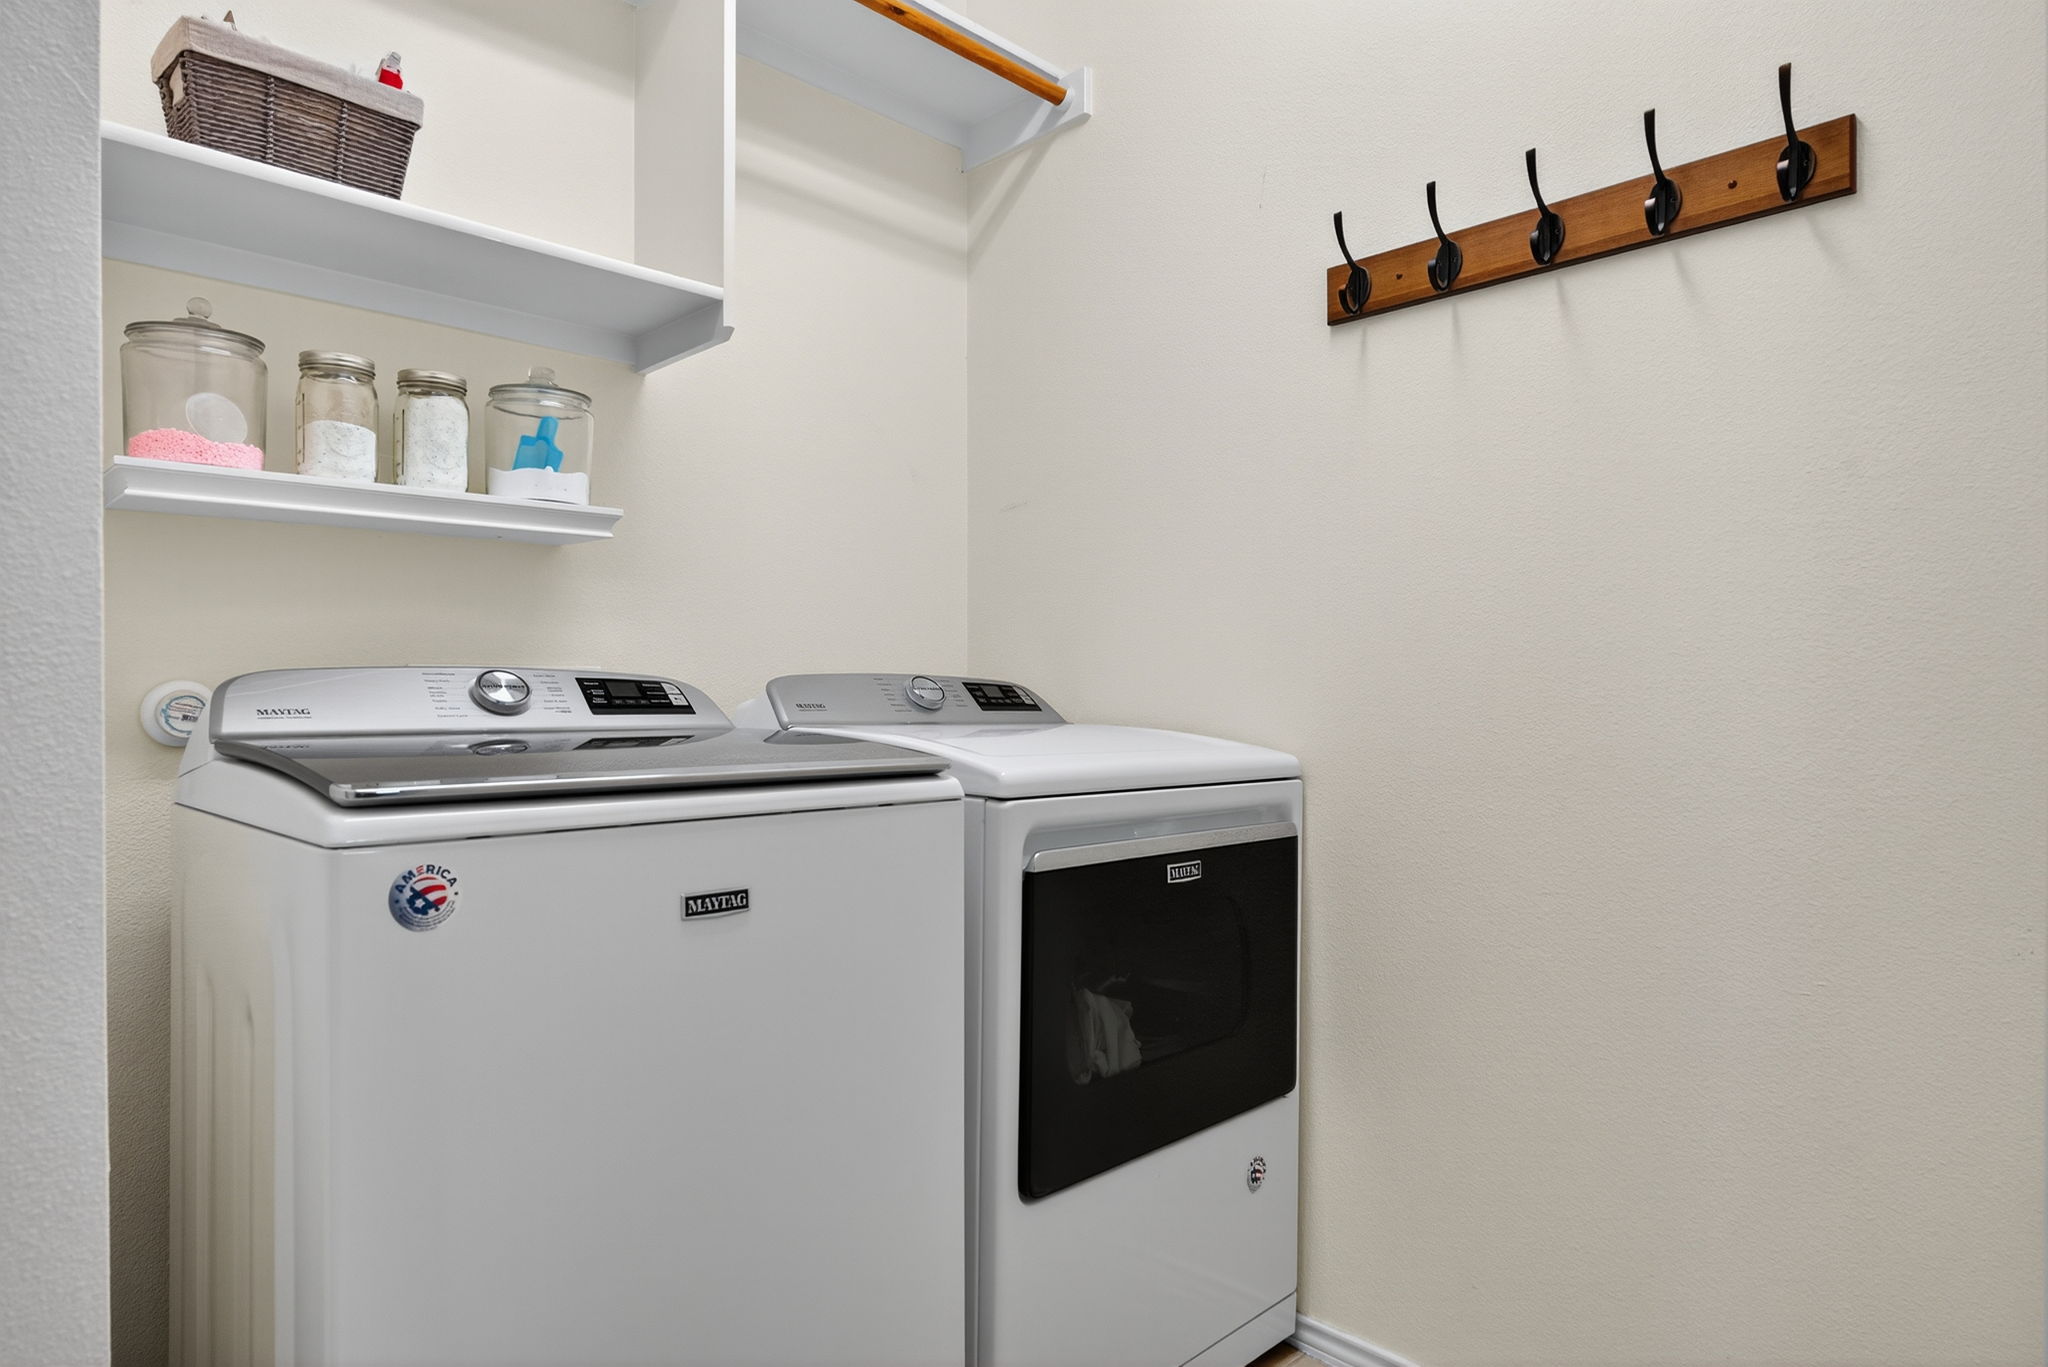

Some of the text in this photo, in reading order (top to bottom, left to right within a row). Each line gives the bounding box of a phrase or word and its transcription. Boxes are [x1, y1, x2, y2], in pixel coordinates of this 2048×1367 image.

[256, 708, 311, 716] MAYTAG
[394, 864, 458, 894] AMERICA
[687, 892, 747, 914] MAYTAG
